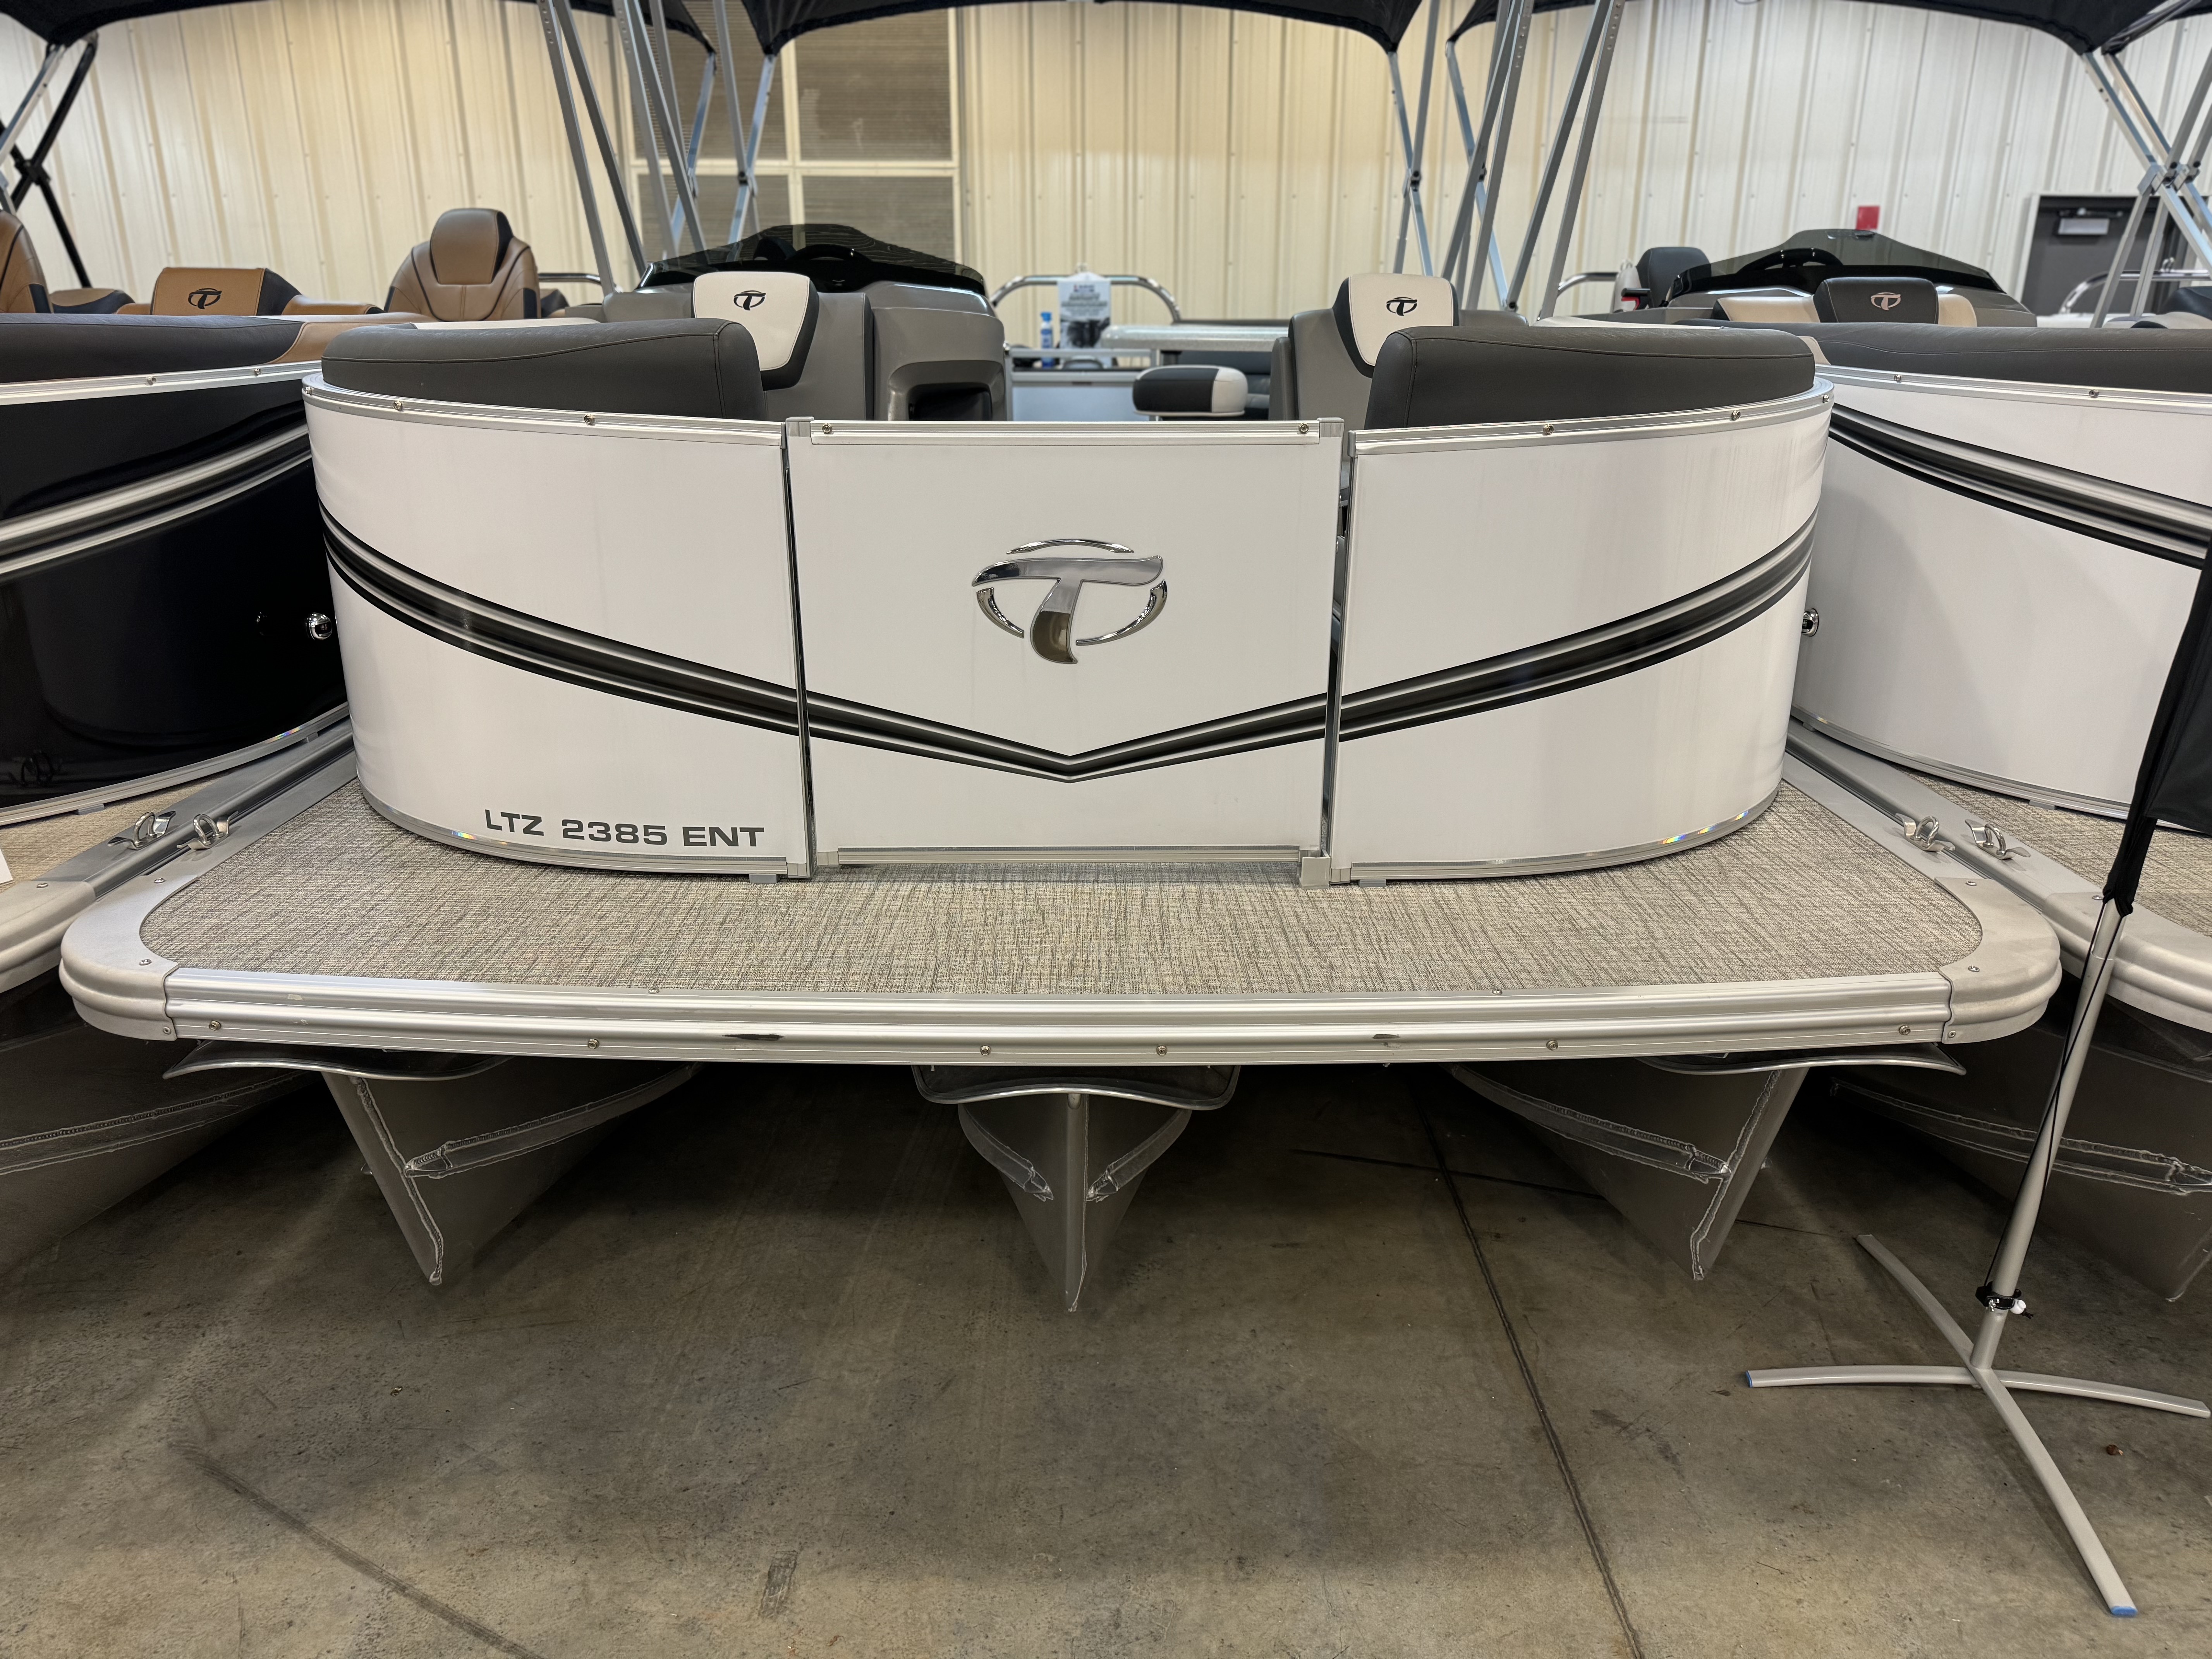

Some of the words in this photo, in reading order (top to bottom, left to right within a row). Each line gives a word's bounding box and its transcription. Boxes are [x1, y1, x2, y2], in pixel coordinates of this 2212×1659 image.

[485, 809, 544, 836] LTZ
[562, 819, 667, 845] 2385
[682, 826, 764, 847] ENT
